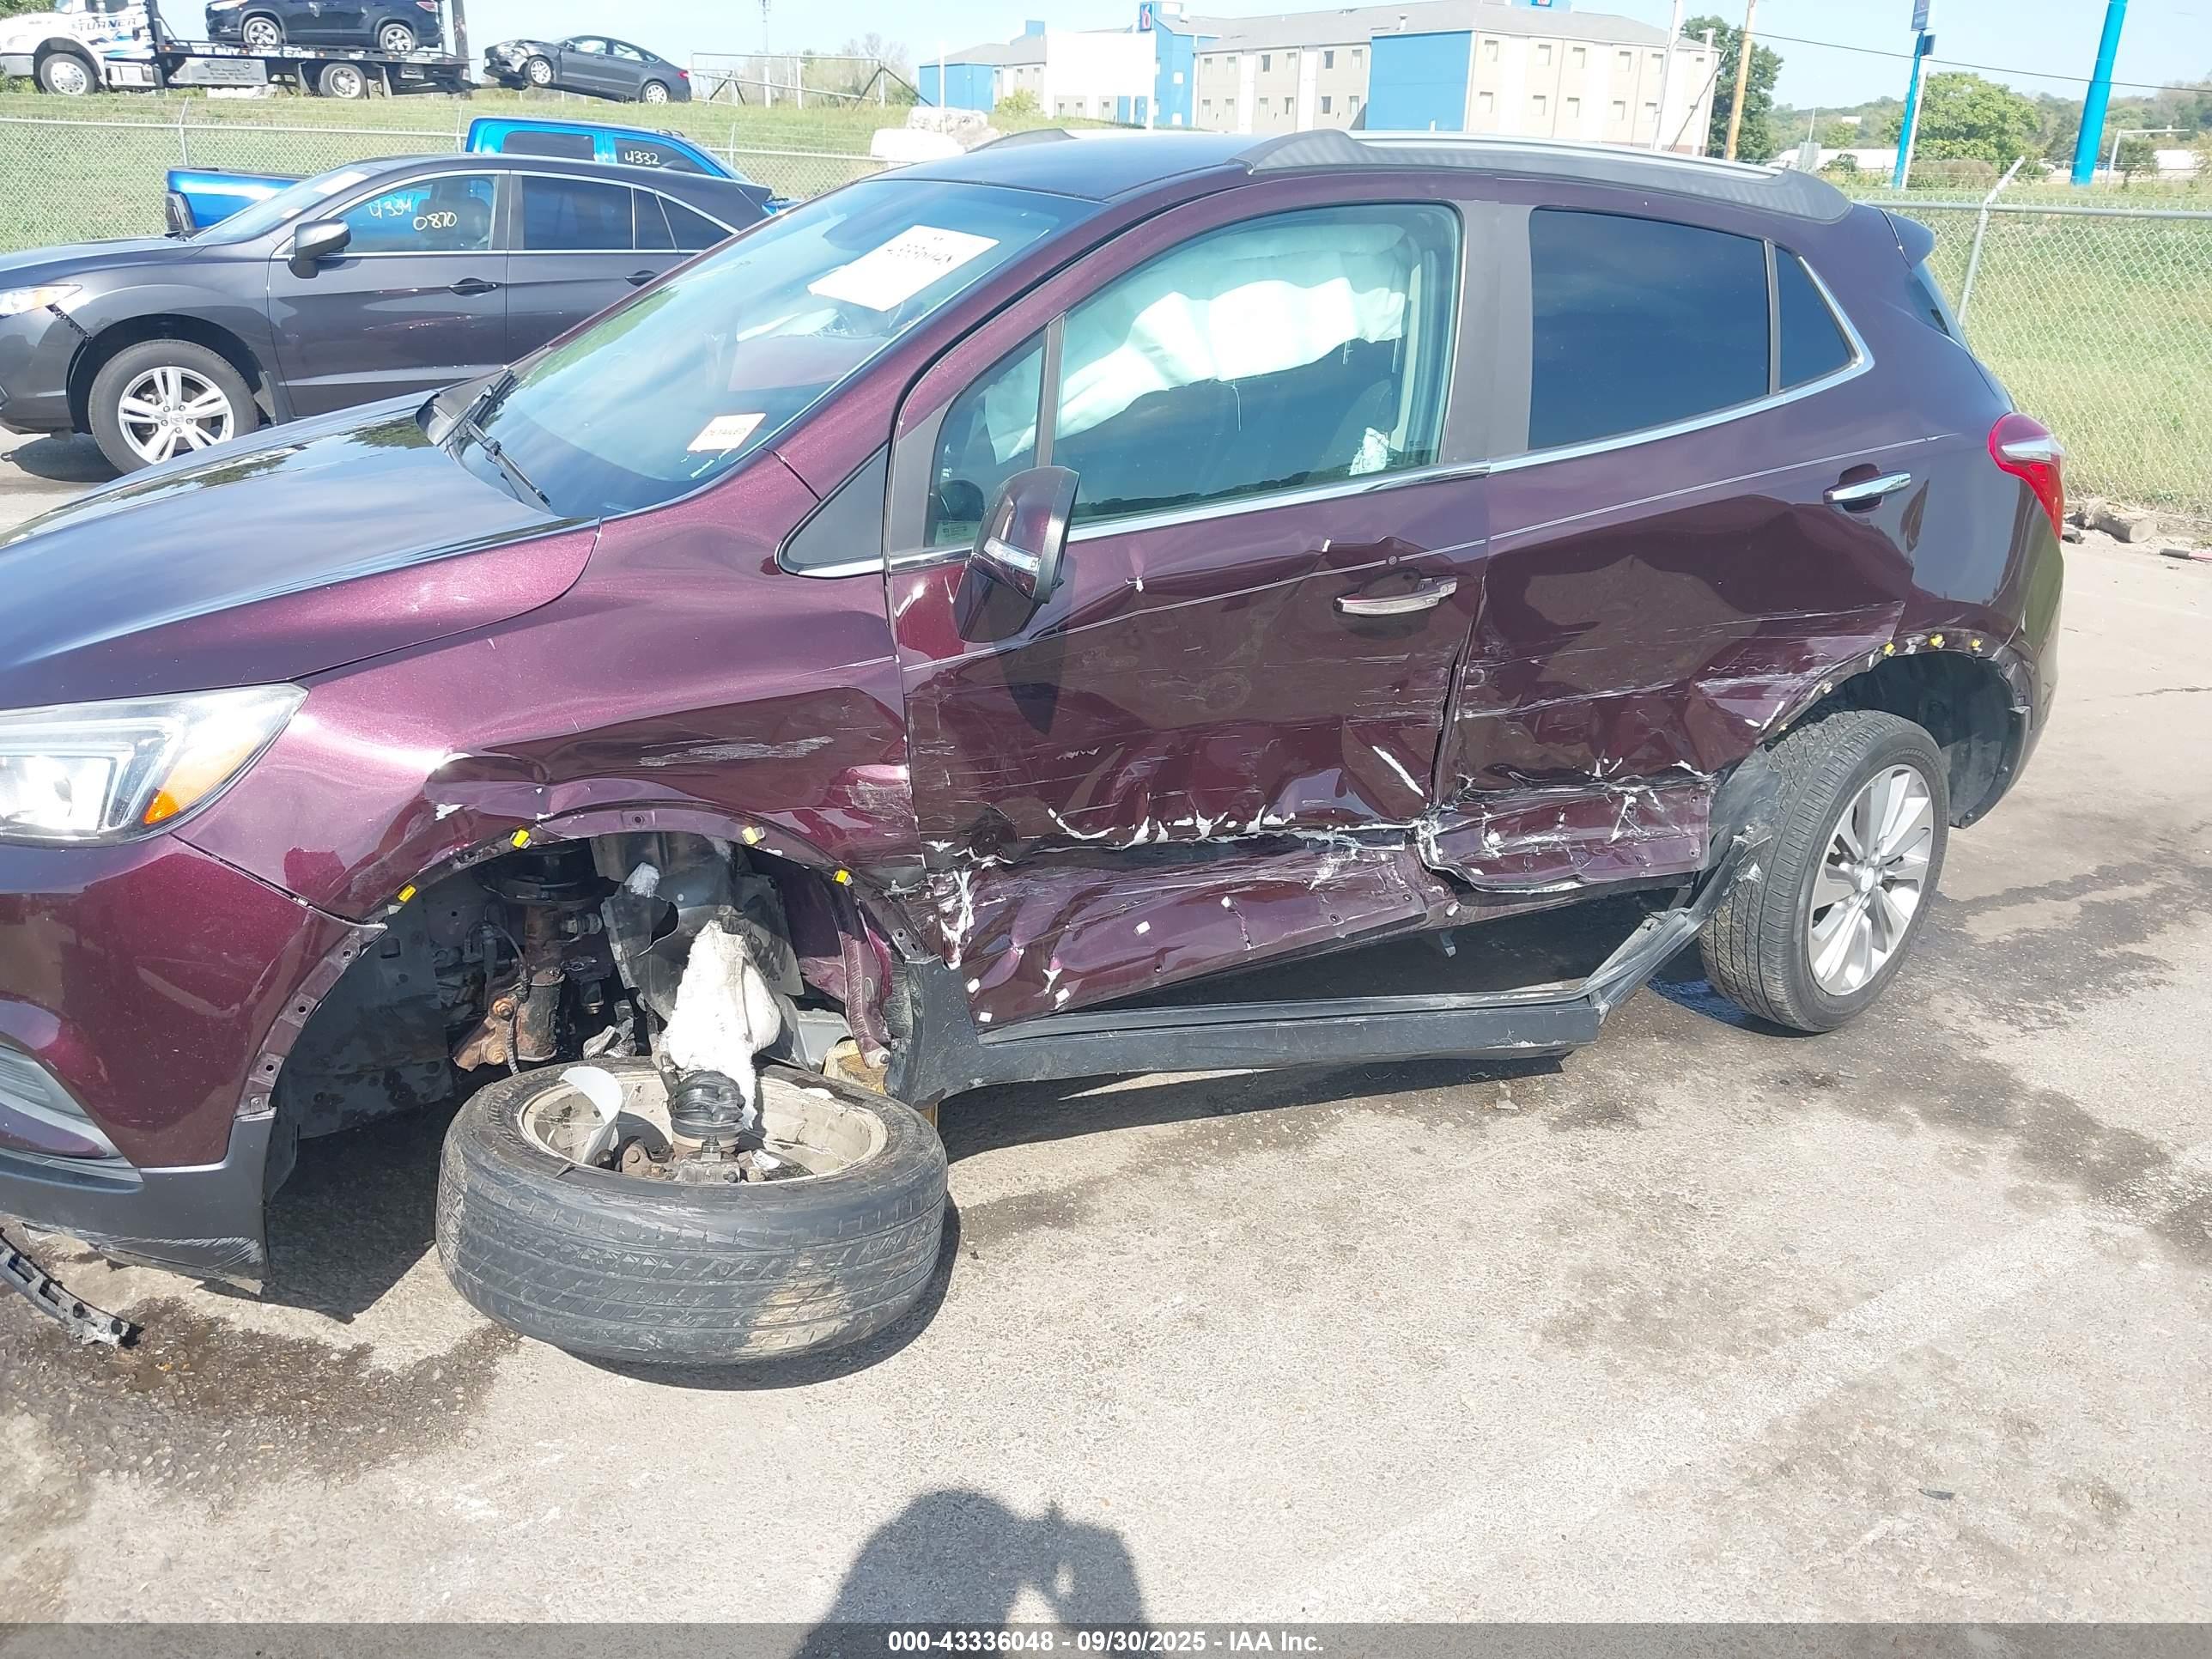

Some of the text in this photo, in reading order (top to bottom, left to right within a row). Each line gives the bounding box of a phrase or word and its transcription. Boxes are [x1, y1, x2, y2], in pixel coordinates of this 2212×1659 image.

[78, 18, 137, 31] TURNER
[191, 46, 316, 58] WE BUY JUNK CARS
[624, 150, 660, 165] 4332
[413, 211, 458, 231] 0870
